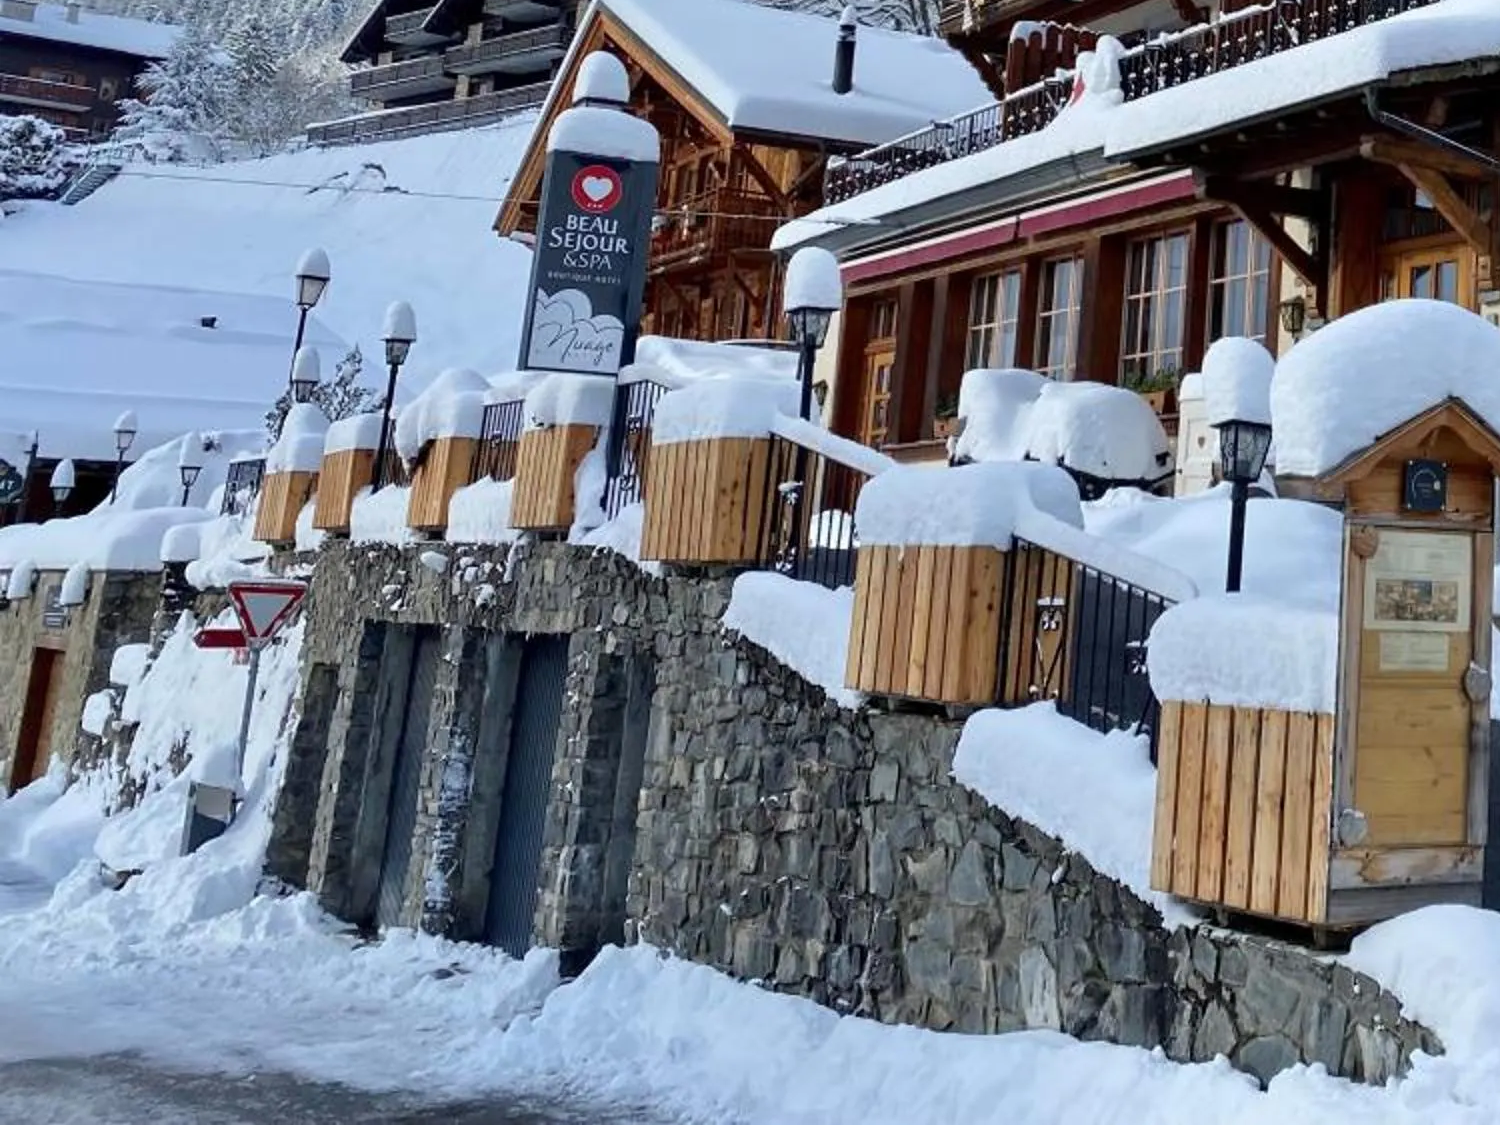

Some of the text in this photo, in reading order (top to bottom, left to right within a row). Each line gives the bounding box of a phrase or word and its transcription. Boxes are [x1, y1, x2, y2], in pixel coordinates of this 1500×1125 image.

[566, 214, 618, 234] BEAU
[549, 226, 630, 254] SEJOUR
[563, 251, 612, 270] &SPA
[537, 321, 613, 366] Nuage
